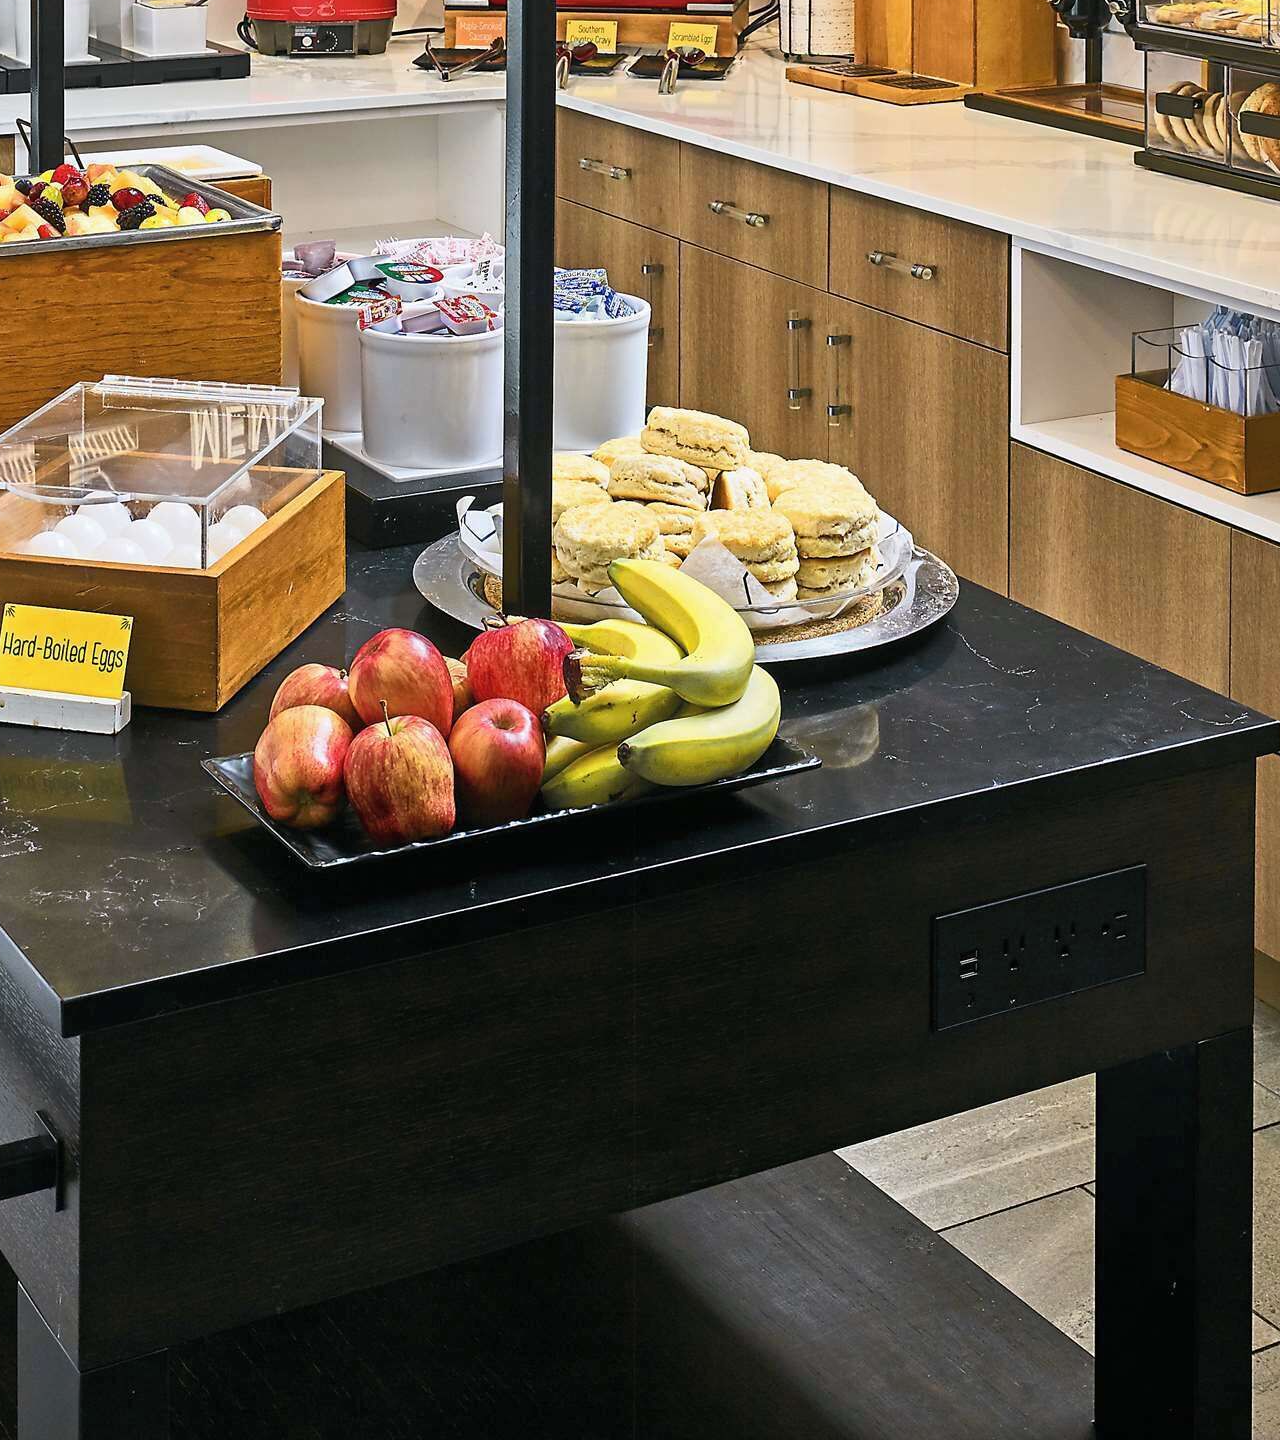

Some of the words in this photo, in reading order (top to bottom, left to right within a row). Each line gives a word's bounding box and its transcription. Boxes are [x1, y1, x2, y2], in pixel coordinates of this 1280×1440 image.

[578, 25, 605, 34] Southern
[672, 32, 700, 43] Scrambled
[702, 33, 713, 44] Eggs
[3, 631, 88, 665] Hard-Boiled
[91, 639, 124, 674] Eggs
